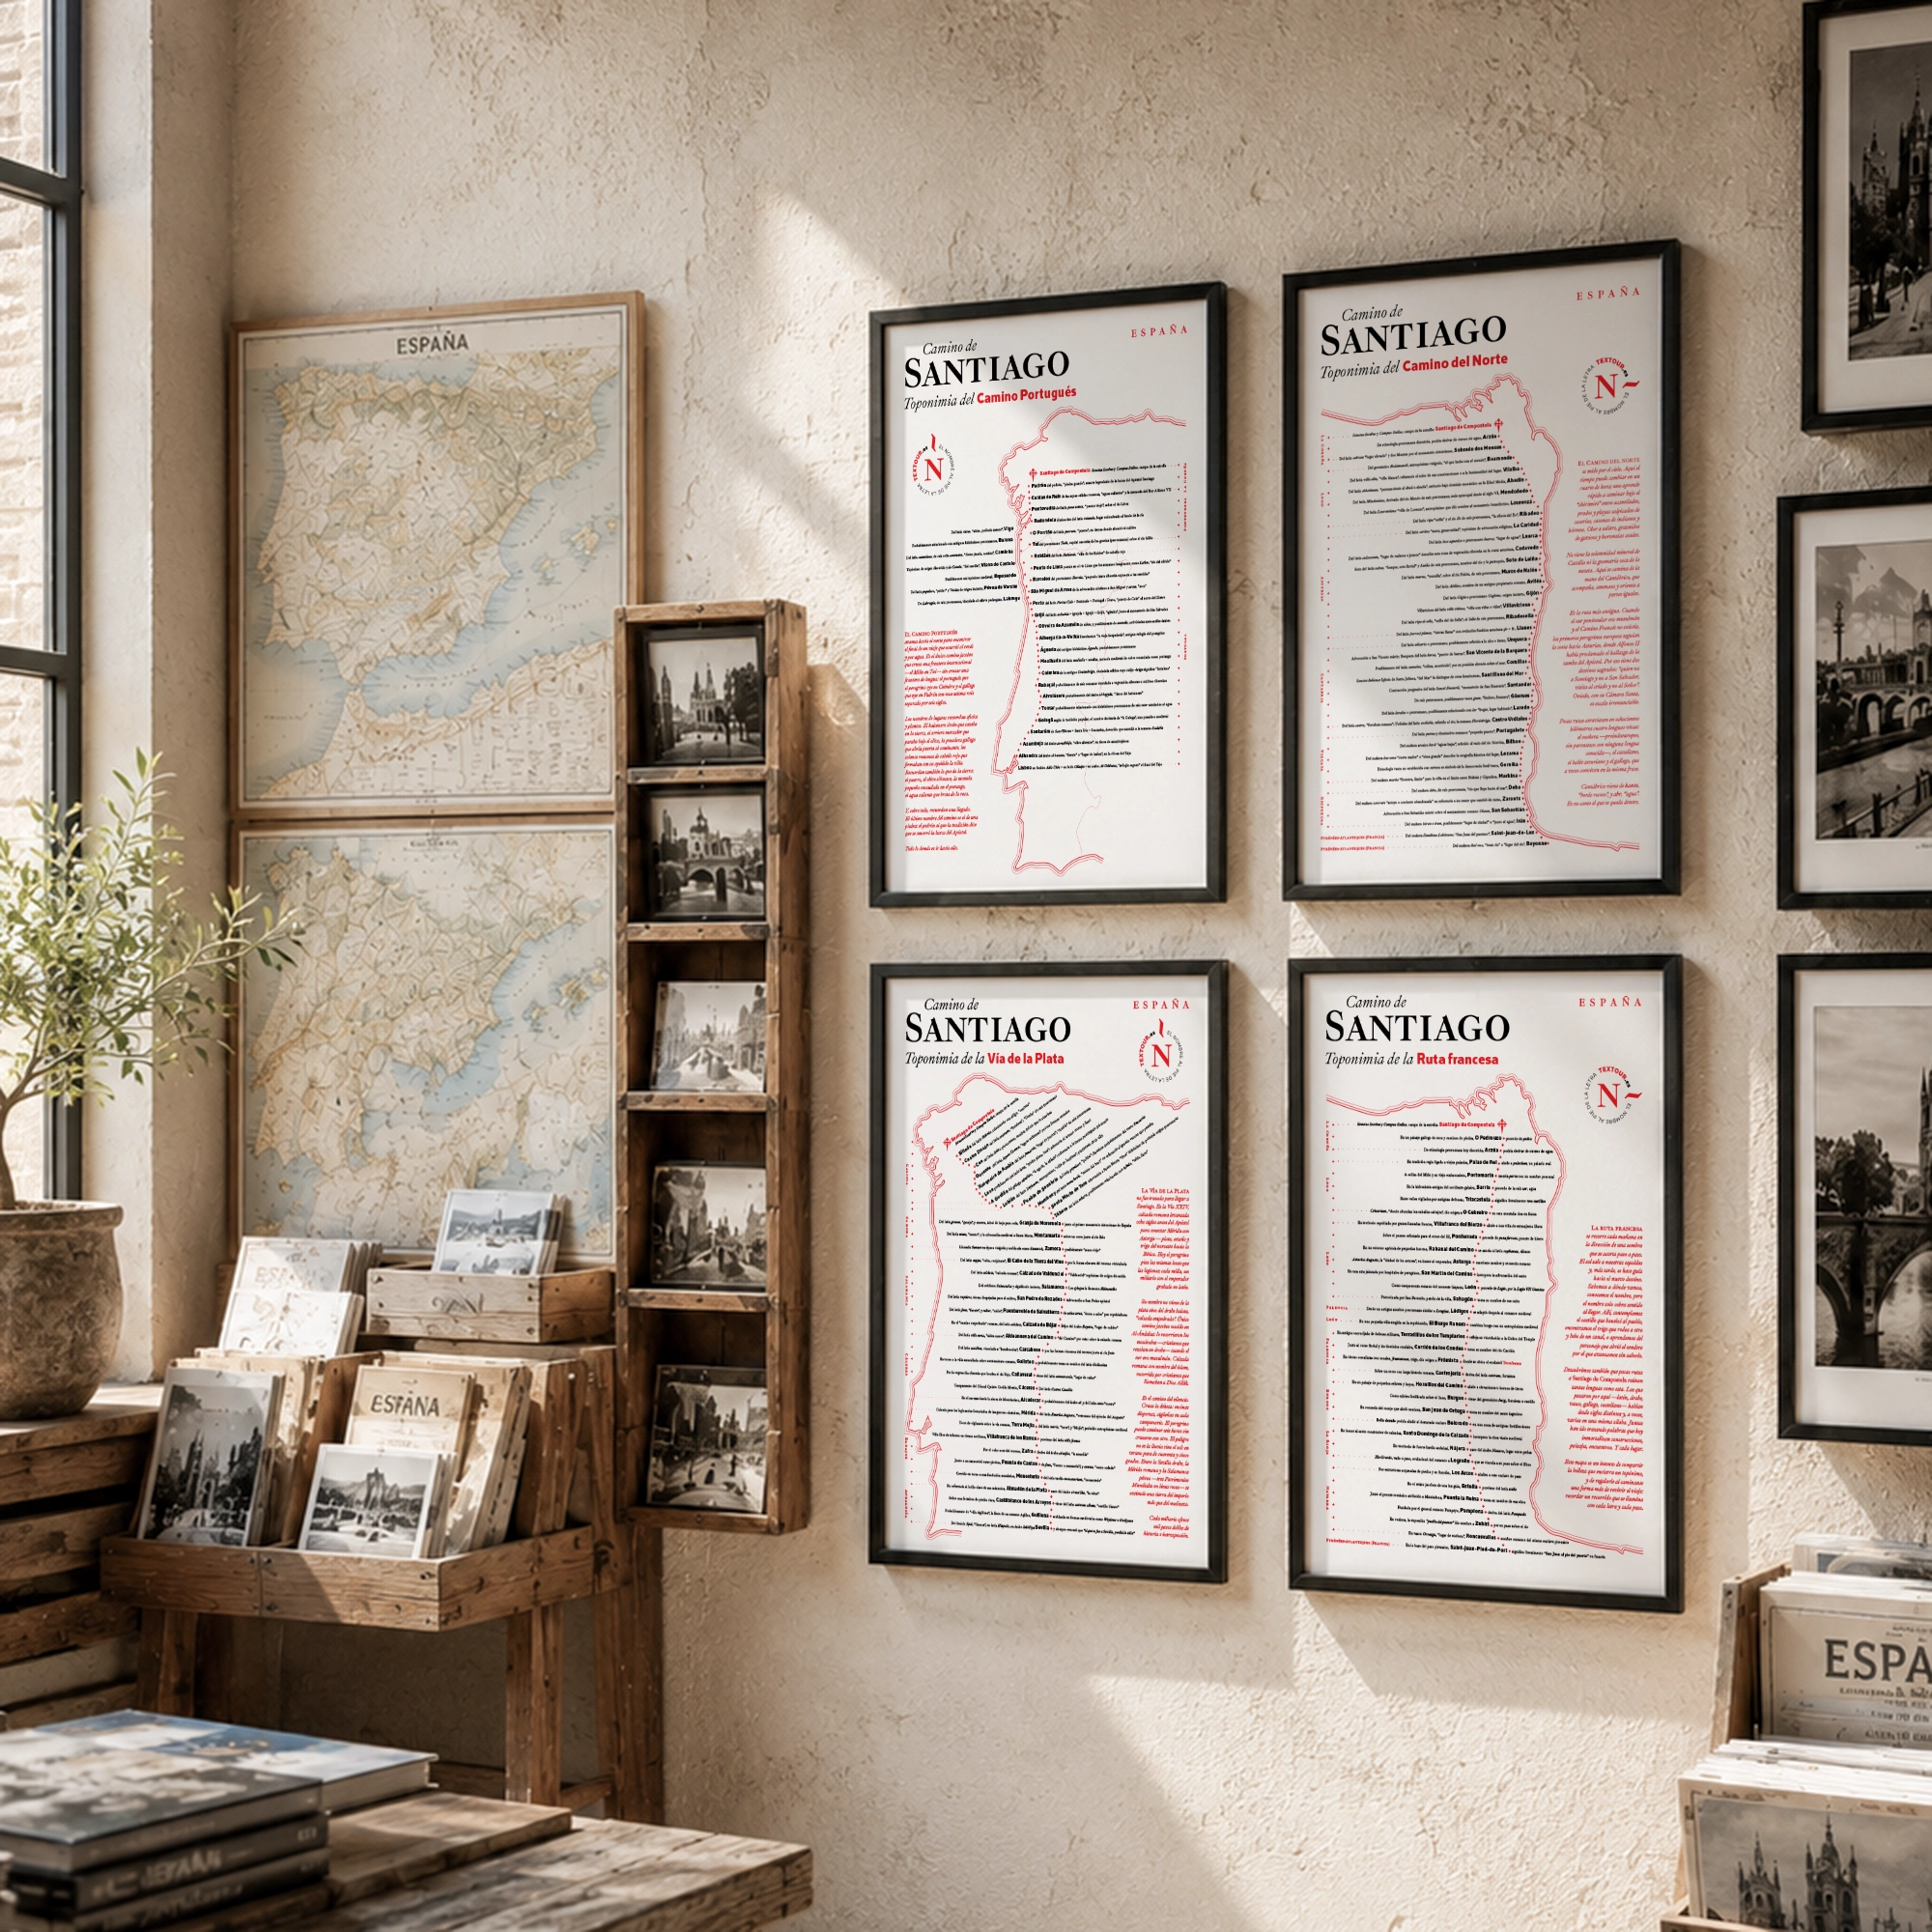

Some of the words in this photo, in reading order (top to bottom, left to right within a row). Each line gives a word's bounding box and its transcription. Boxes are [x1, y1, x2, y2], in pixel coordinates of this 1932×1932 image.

[1577, 286, 1639, 300] ESPAÑA
[1343, 306, 1387, 321] Camino
[1389, 304, 1403, 317] de
[1131, 324, 1187, 337] ESPAÑA
[1321, 314, 1506, 356] SANTIAGO
[397, 329, 469, 355] ESPAÑA
[923, 341, 963, 355] Camino
[966, 339, 977, 352] de
[905, 350, 1069, 389] SANTIAGO
[1321, 362, 1379, 382] Toponimia
[1383, 360, 1400, 374] del
[1403, 358, 1449, 371] Camino
[1451, 355, 1469, 367] del
[1472, 354, 1508, 366] Norte
[904, 394, 956, 412] Toponimia
[959, 392, 975, 405] del
[977, 391, 1018, 404] Camino
[1020, 385, 1076, 401] Portugués
[924, 998, 964, 1010] Camino
[967, 998, 979, 1010] de
[1133, 999, 1189, 1009] ESPAÑA
[1347, 995, 1391, 1008] Camino
[1394, 995, 1406, 1008] de
[1579, 996, 1641, 1007] ESPAÑA
[906, 1012, 1070, 1042] SANTIAGO
[1326, 1010, 1510, 1041] SANTIAGO
[905, 1052, 958, 1067] Toponimia
[961, 1052, 973, 1064] de
[976, 1052, 984, 1064] la
[987, 1053, 1005, 1064] Vía
[1008, 1053, 1021, 1064] de
[1023, 1053, 1033, 1064] la
[1036, 1053, 1064, 1064] Plata
[1325, 1052, 1384, 1068] Toponimia
[1387, 1052, 1400, 1065] de
[1403, 1052, 1413, 1065] la
[1417, 1053, 1445, 1065] Ruta
[1448, 1053, 1498, 1065] francesa
